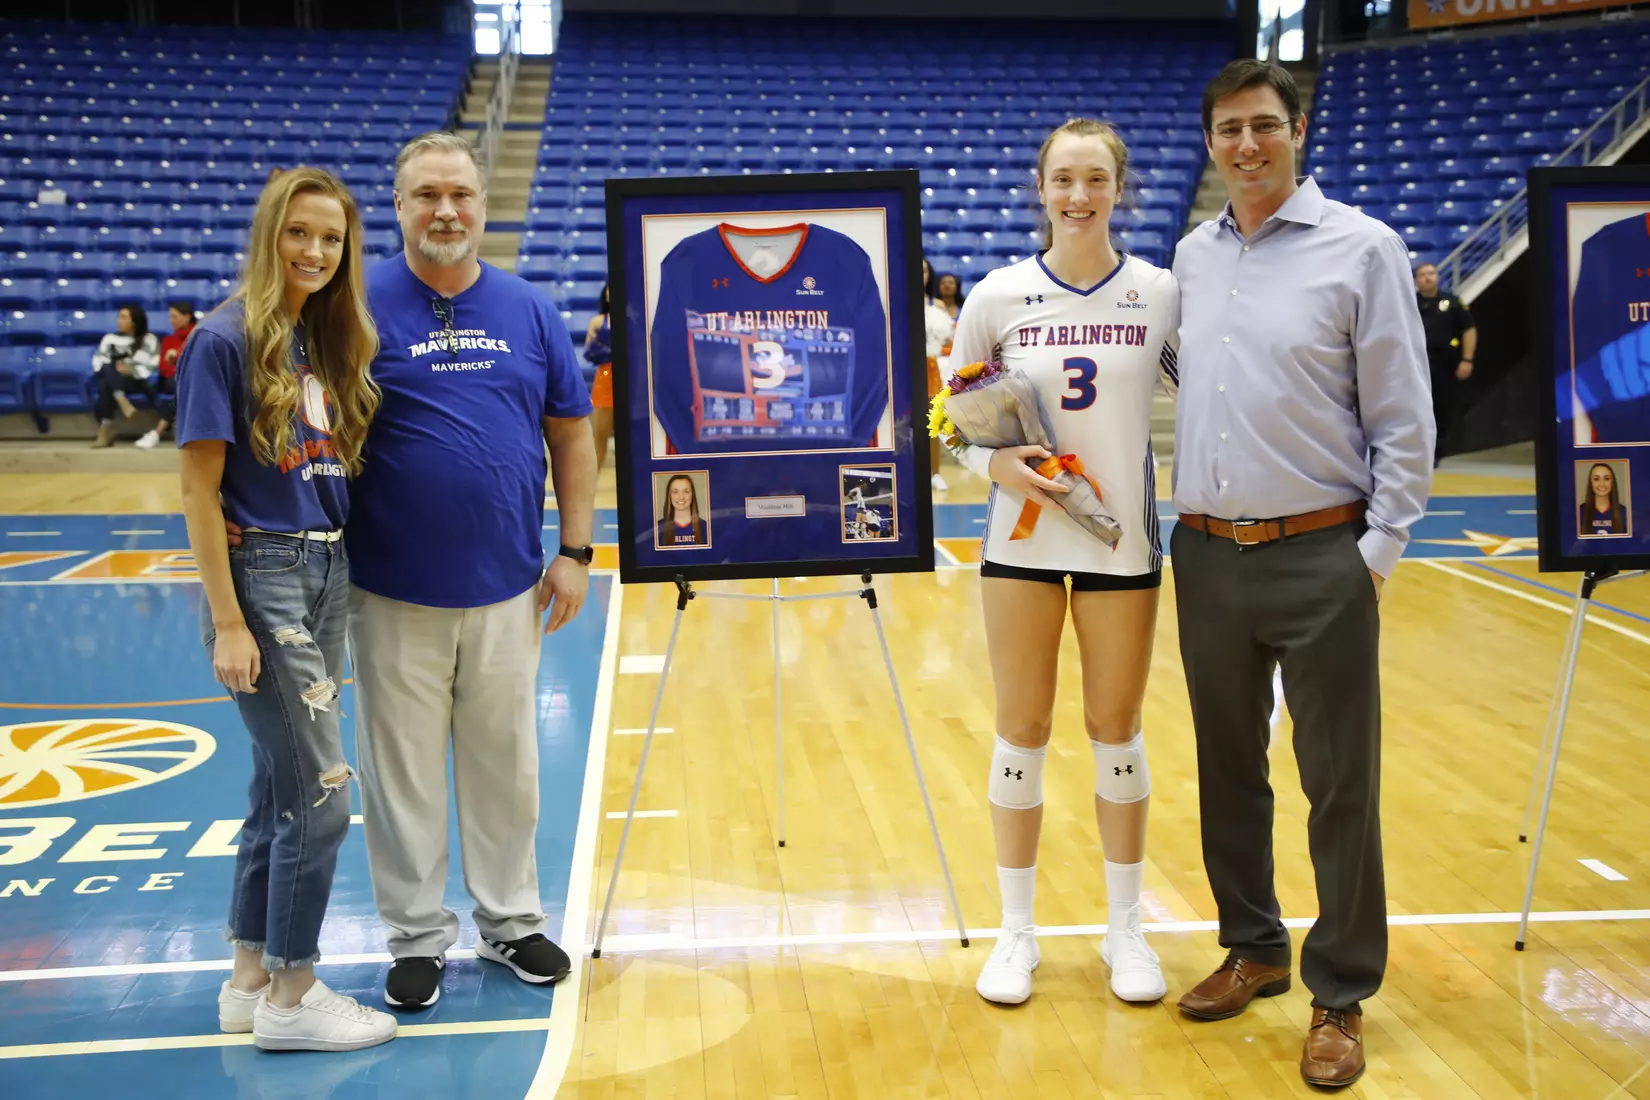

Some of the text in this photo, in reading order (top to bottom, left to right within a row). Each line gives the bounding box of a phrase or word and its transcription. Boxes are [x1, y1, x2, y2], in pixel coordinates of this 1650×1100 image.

[706, 310, 829, 331] UT ARLINGTON
[1627, 301, 1650, 322] UT
[440, 329, 486, 337] ALINGTON
[1018, 324, 1147, 347] UT ARLINGTON
[752, 341, 786, 389] 3
[1060, 356, 1098, 411] 3
[0, 816, 247, 866] BEL
